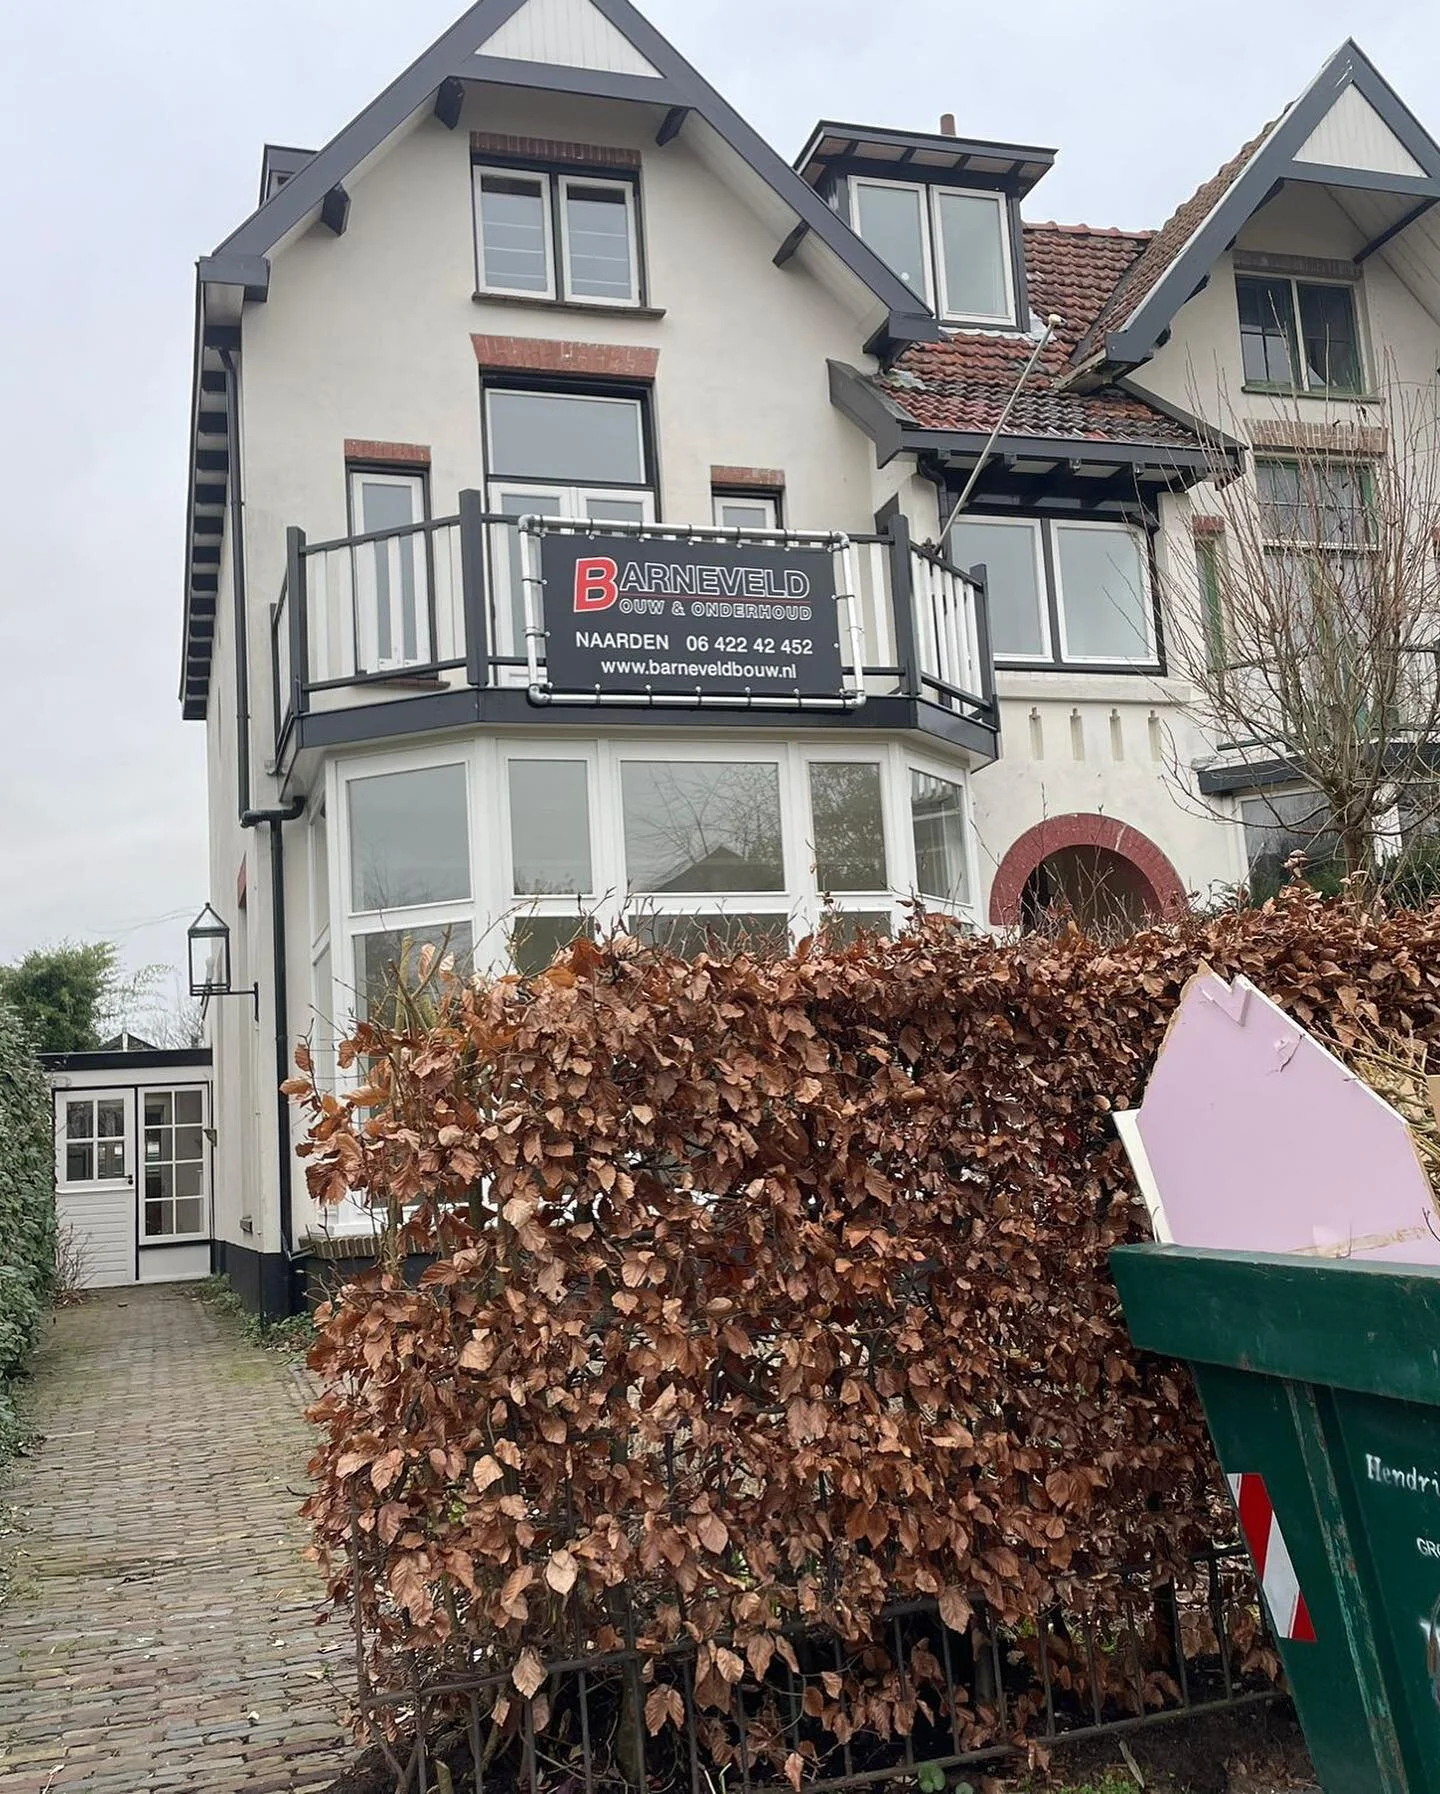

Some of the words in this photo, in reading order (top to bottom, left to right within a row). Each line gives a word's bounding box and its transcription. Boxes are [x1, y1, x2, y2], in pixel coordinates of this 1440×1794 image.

[573, 557, 810, 612] BARNEVELD
[671, 601, 686, 616] &
[691, 601, 812, 621] ONDERHOUD
[575, 631, 669, 650] NAARDEN
[686, 635, 709, 652] 06
[714, 636, 748, 653] 422
[753, 638, 776, 654] 42
[780, 639, 813, 655] 452
[601, 659, 797, 679] www.barneveldbouw.nl
